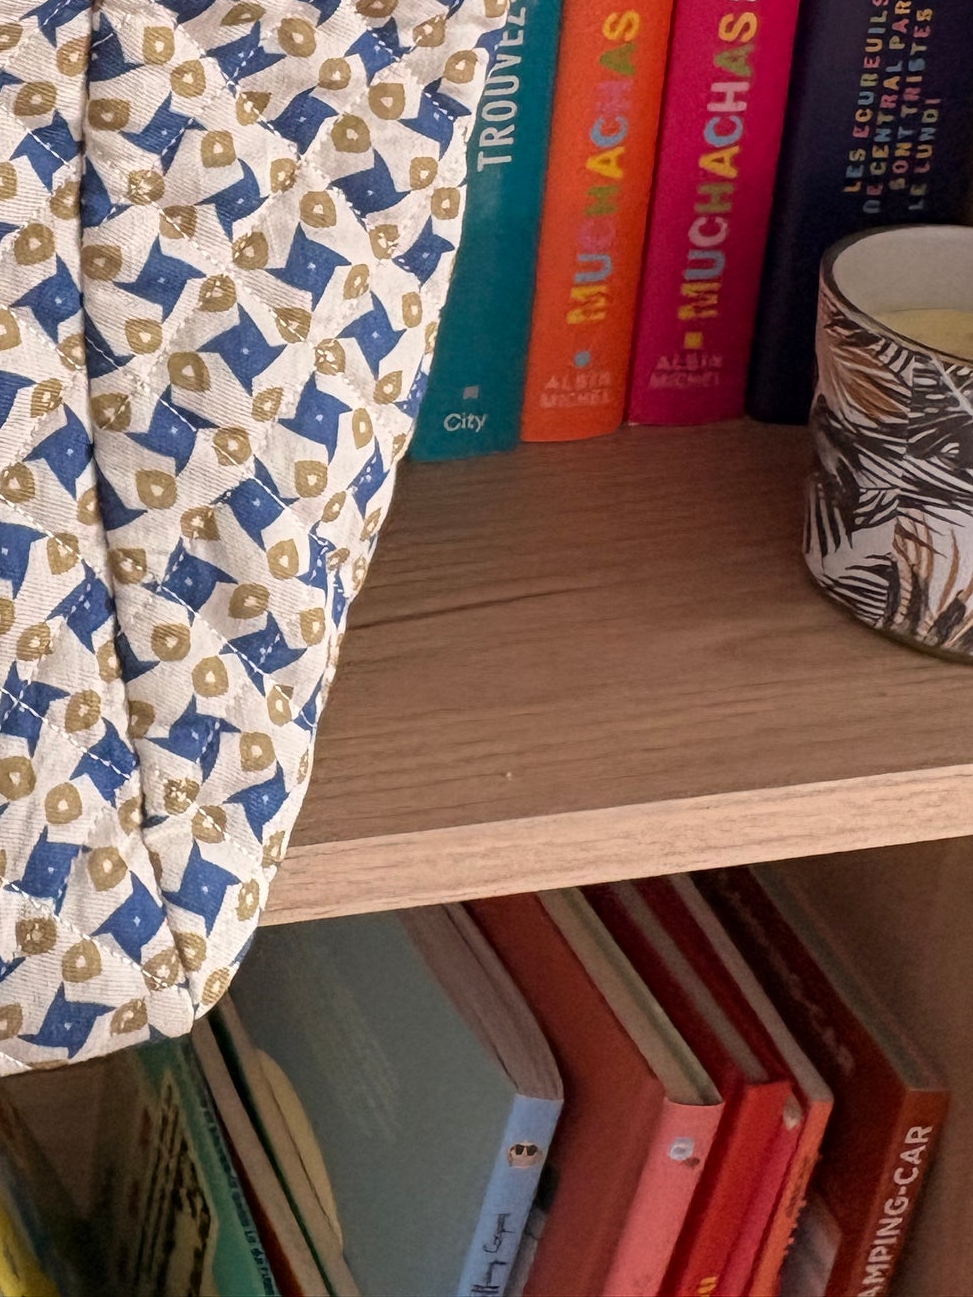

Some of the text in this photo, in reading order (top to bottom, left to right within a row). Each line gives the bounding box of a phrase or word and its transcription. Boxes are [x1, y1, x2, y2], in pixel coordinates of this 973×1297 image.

[870, 60, 903, 176] CENTRAL
[888, 8, 933, 190] SONT TRISTES
[908, 98, 941, 210] LE LUNDI
[566, 9, 641, 324] MUCHACHAS
[678, 12, 758, 321] MUCHACHAS
[843, 147, 866, 192] LES
[863, 181, 884, 214] DE
[443, 412, 487, 433] City
